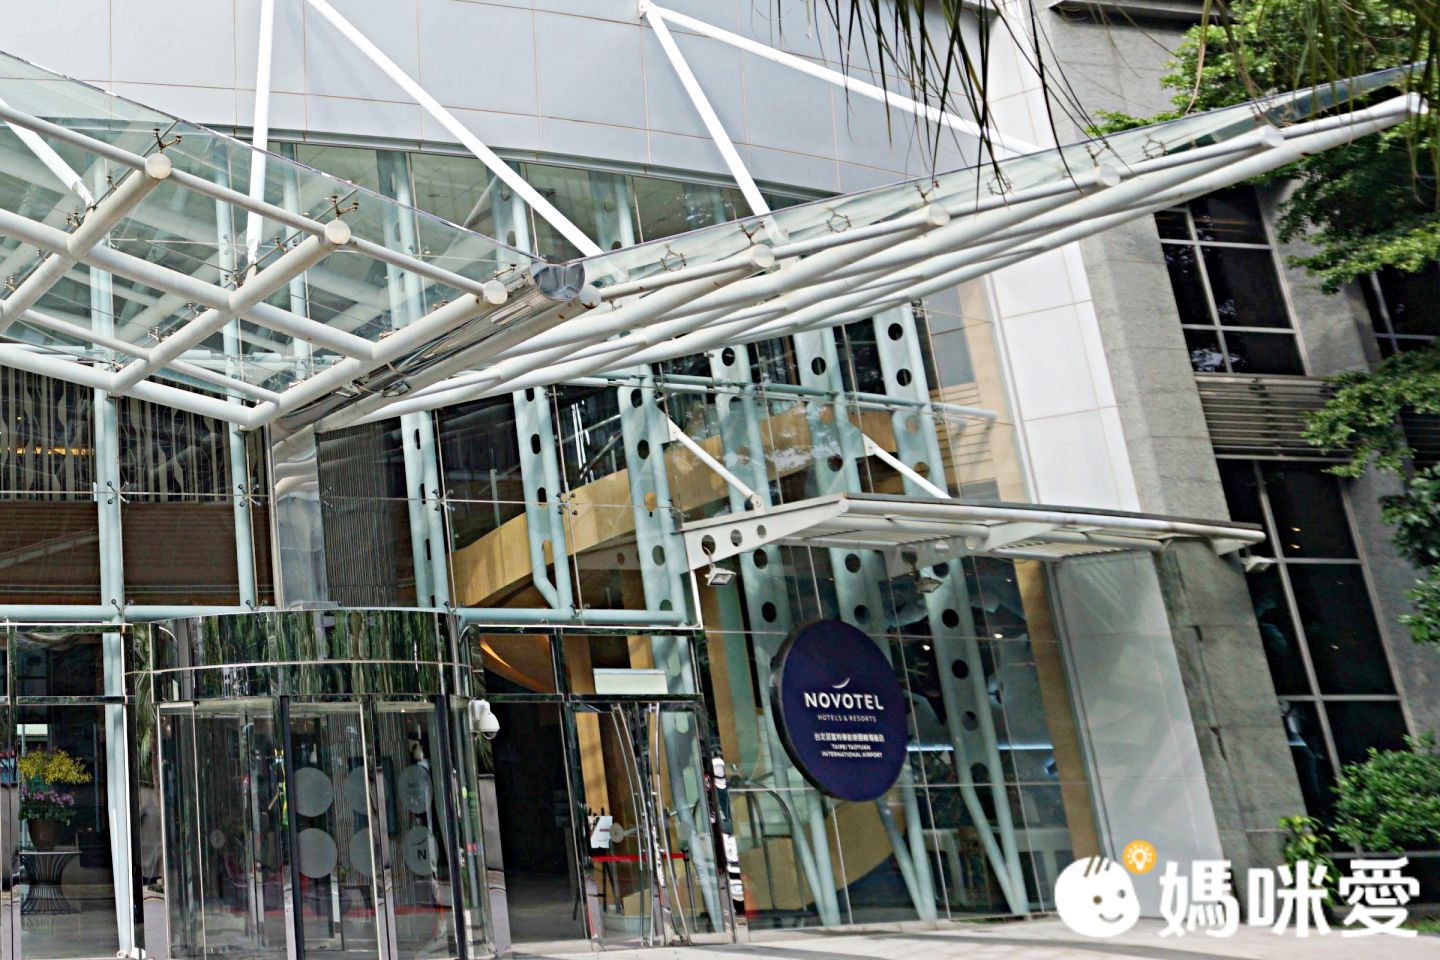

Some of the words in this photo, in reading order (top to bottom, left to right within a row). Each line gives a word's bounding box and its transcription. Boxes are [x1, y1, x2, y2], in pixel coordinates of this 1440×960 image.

[804, 692, 884, 710] NOVOTEL
[821, 750, 862, 758] INTERNATIONAL
[417, 849, 427, 860] N
